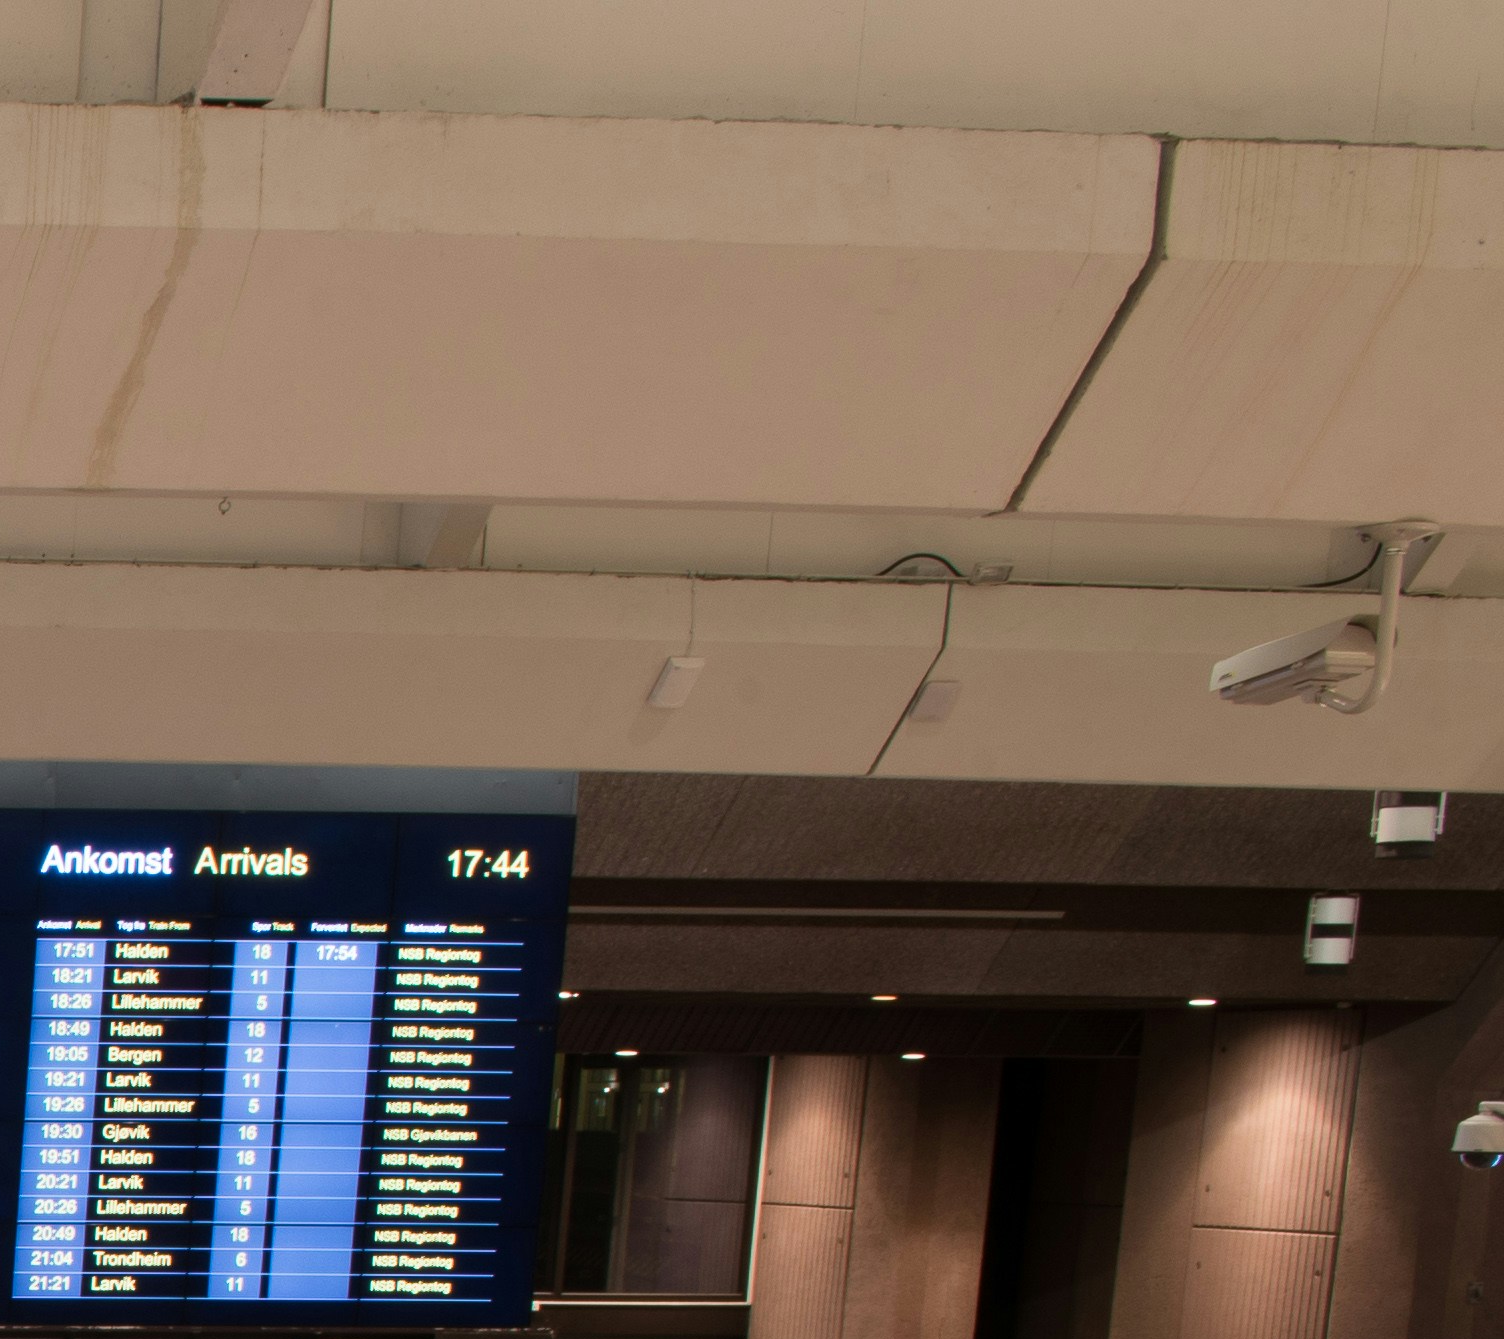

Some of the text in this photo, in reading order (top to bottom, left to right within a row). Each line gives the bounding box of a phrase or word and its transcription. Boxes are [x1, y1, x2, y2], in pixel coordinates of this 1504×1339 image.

[40, 845, 310, 877] Ankomst Arrivals
[447, 849, 530, 879] 17:44
[54, 941, 95, 958] 17:51
[115, 942, 169, 959] Halden
[399, 947, 425, 960] NSB
[52, 967, 93, 984] 18:21
[114, 968, 159, 984] Larvik
[50, 992, 93, 1009] 18:26
[112, 993, 203, 1010] Lillehammer
[49, 1020, 91, 1036] 18:49
[110, 1021, 163, 1037] Halden
[47, 1045, 89, 1062] 19:05
[108, 1046, 162, 1065] Bergen
[45, 1070, 86, 1087] 19:21
[106, 1071, 152, 1087] Larvik
[43, 1096, 86, 1112] 19:26
[104, 1097, 196, 1113] Lillehammer
[42, 1122, 84, 1139] 19:30
[102, 1123, 150, 1143] Gjøvik
[39, 1148, 81, 1164] 19:51
[100, 1149, 153, 1165] Halden
[36, 1173, 79, 1190] 20:21
[98, 1174, 144, 1190] Larvik
[34, 1198, 78, 1215] 20:26
[97, 1199, 188, 1215] Lillehammer
[32, 1224, 77, 1241] 20:49
[95, 1226, 148, 1242] Halden
[31, 1250, 74, 1266] 21:04
[93, 1250, 172, 1267] Trondheim
[29, 1275, 71, 1291] 21:21
[91, 1275, 136, 1291] Larvik
